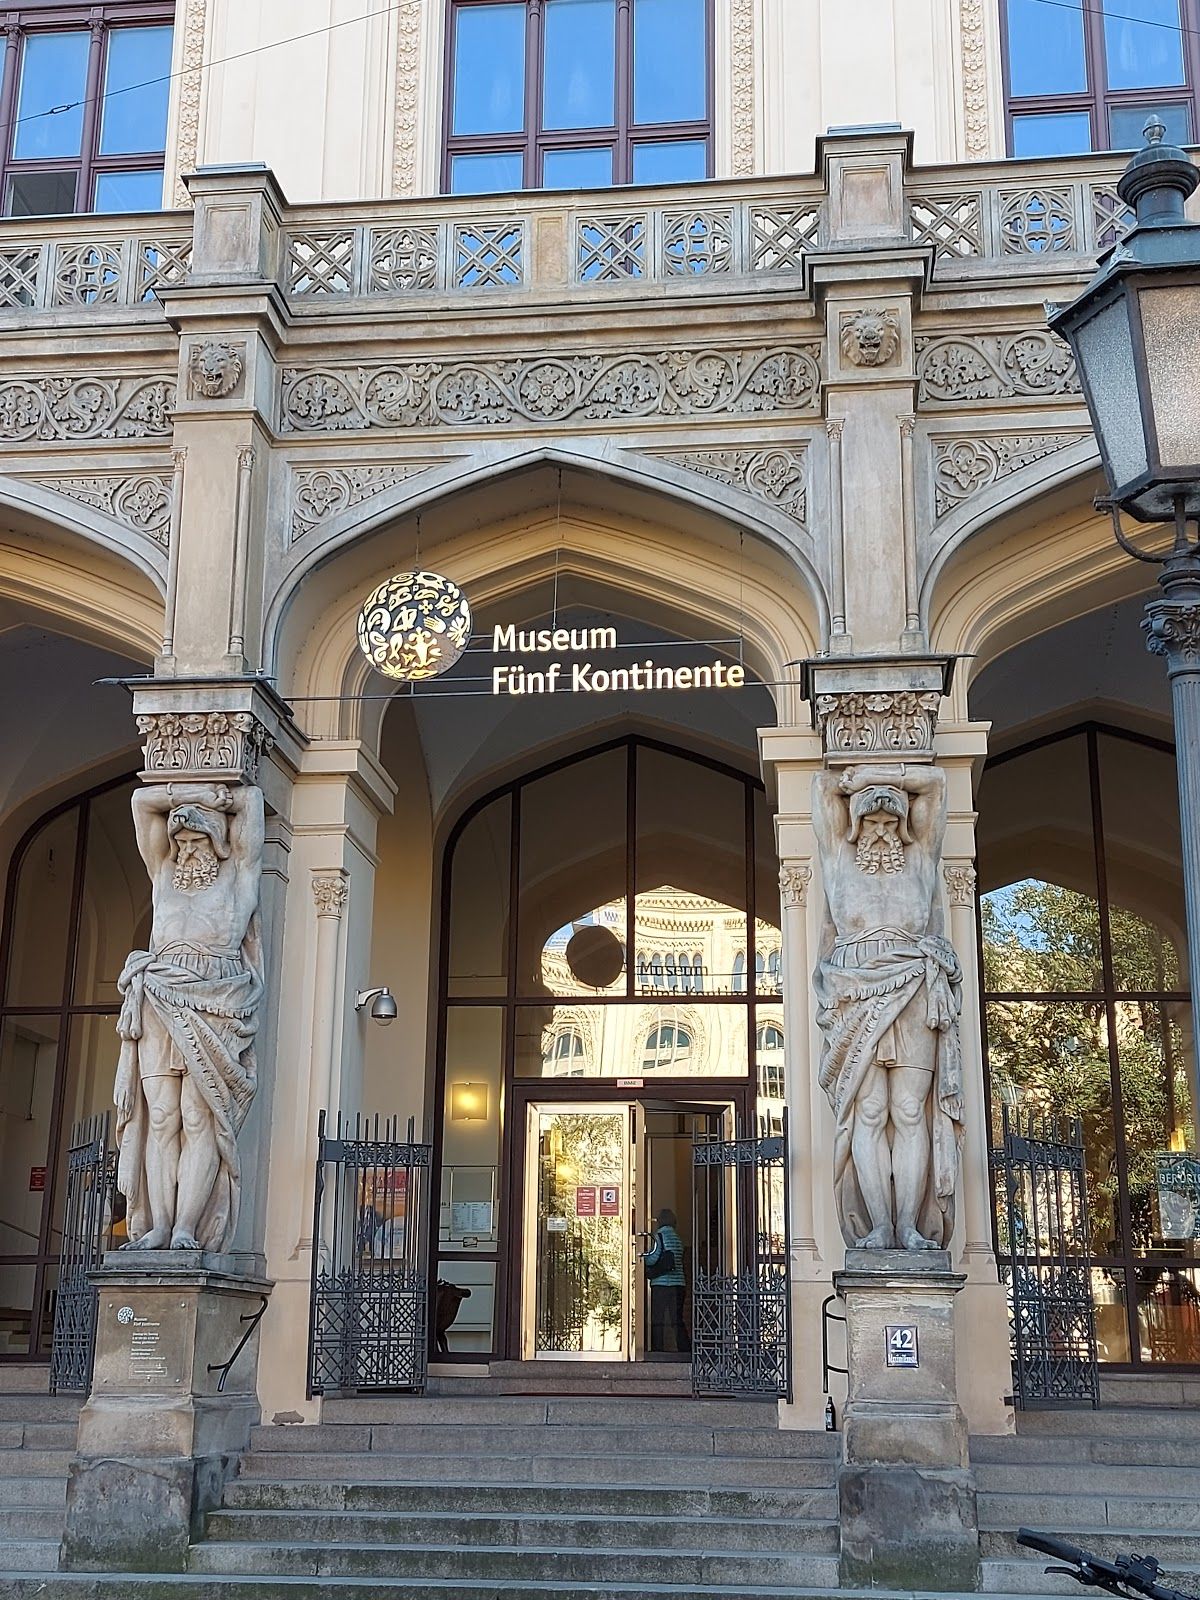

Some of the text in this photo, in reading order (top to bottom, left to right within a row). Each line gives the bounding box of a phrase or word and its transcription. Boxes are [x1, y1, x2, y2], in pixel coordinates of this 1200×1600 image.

[493, 624, 617, 652] Museum
[492, 660, 745, 695] Fünf Kontinente
[891, 1329, 913, 1348] 42
